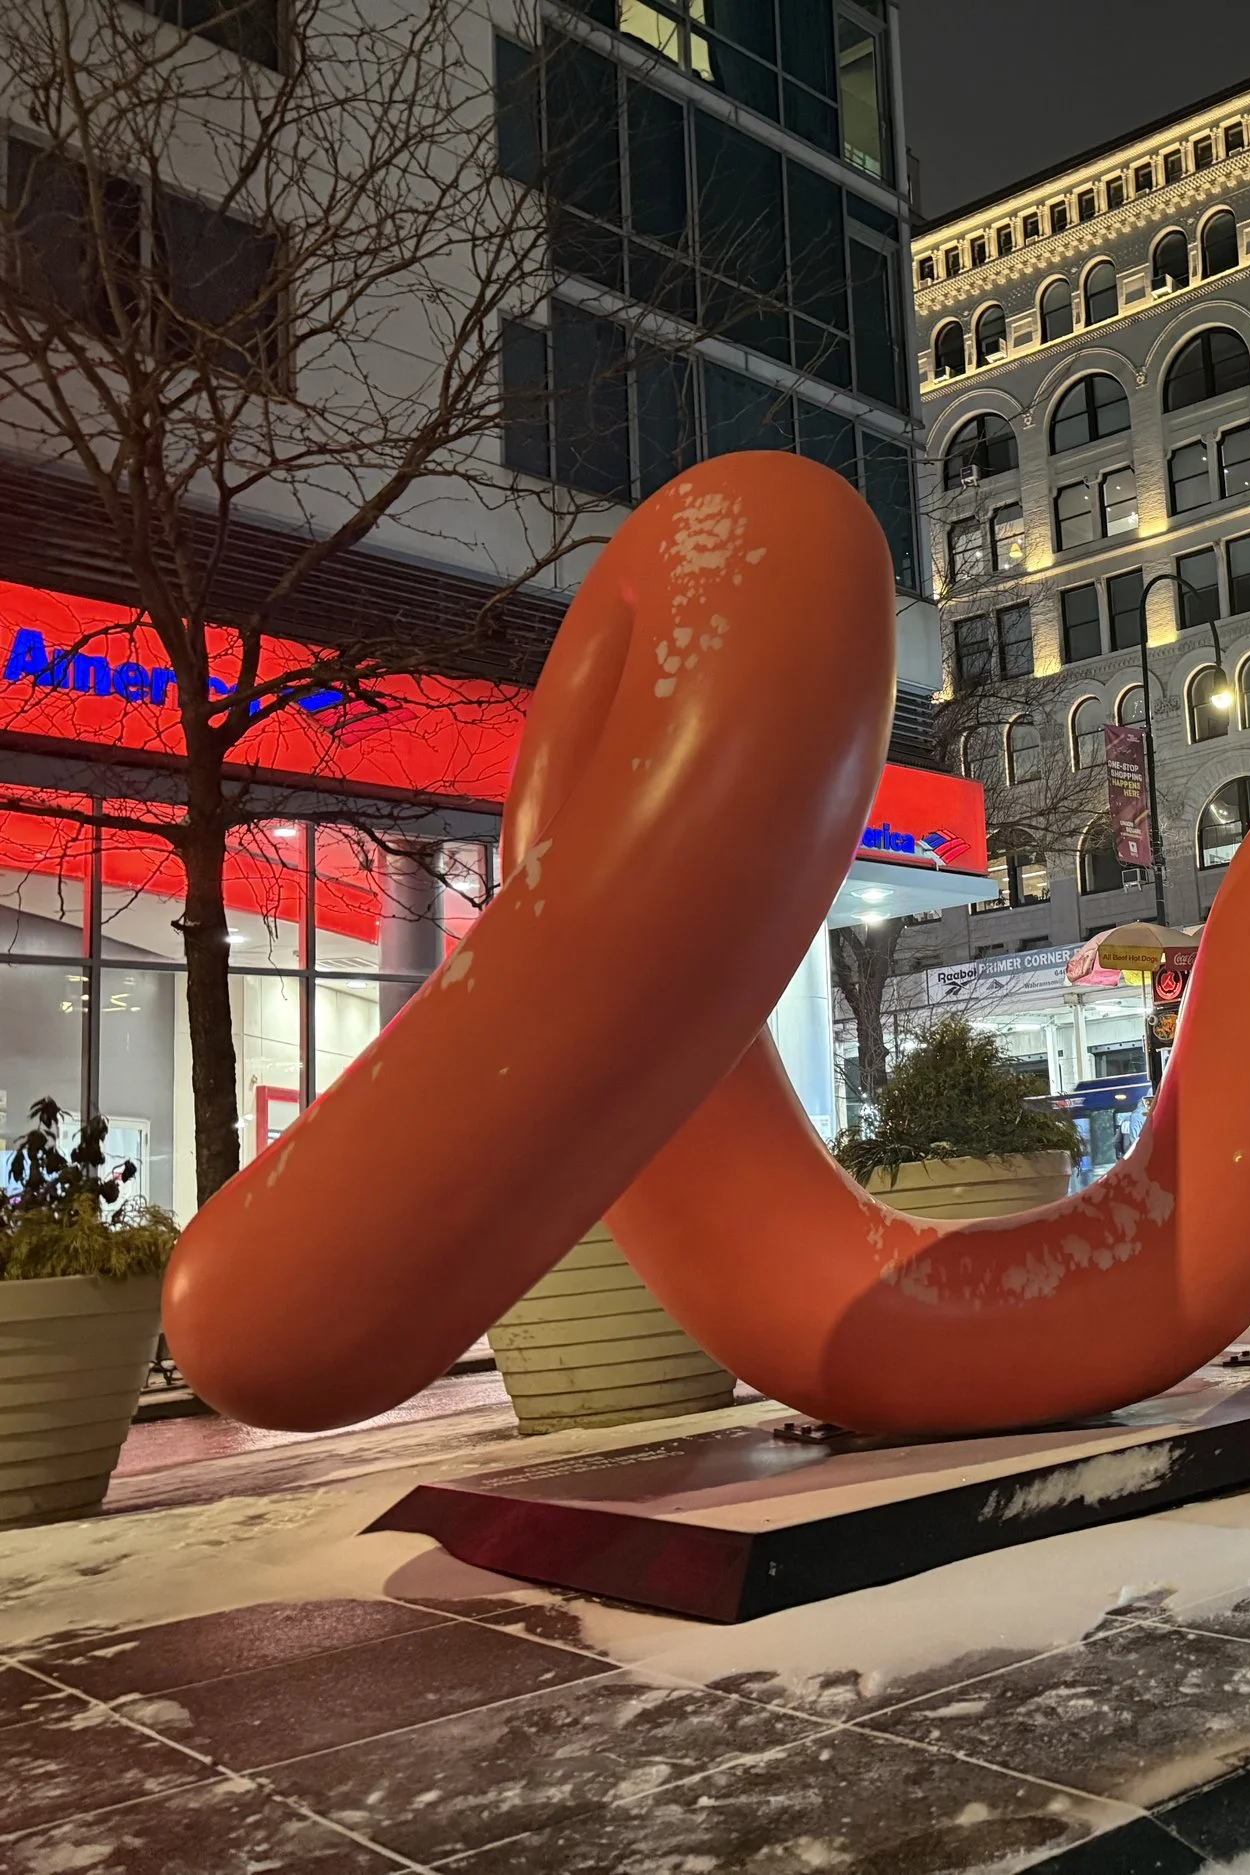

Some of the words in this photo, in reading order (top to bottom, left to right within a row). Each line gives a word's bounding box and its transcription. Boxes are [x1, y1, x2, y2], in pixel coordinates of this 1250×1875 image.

[1107, 760, 1139, 772] ONE-STOP
[1110, 769, 1142, 782] SHOPPING
[1112, 779, 1140, 790] HAPPENS
[1123, 789, 1140, 799] HERE
[978, 957, 1021, 974] PRIMER
[1024, 950, 1070, 968] CORNER
[1103, 953, 1111, 961] All
[1128, 954, 1141, 962] Hot
[1141, 955, 1158, 964] Dogs
